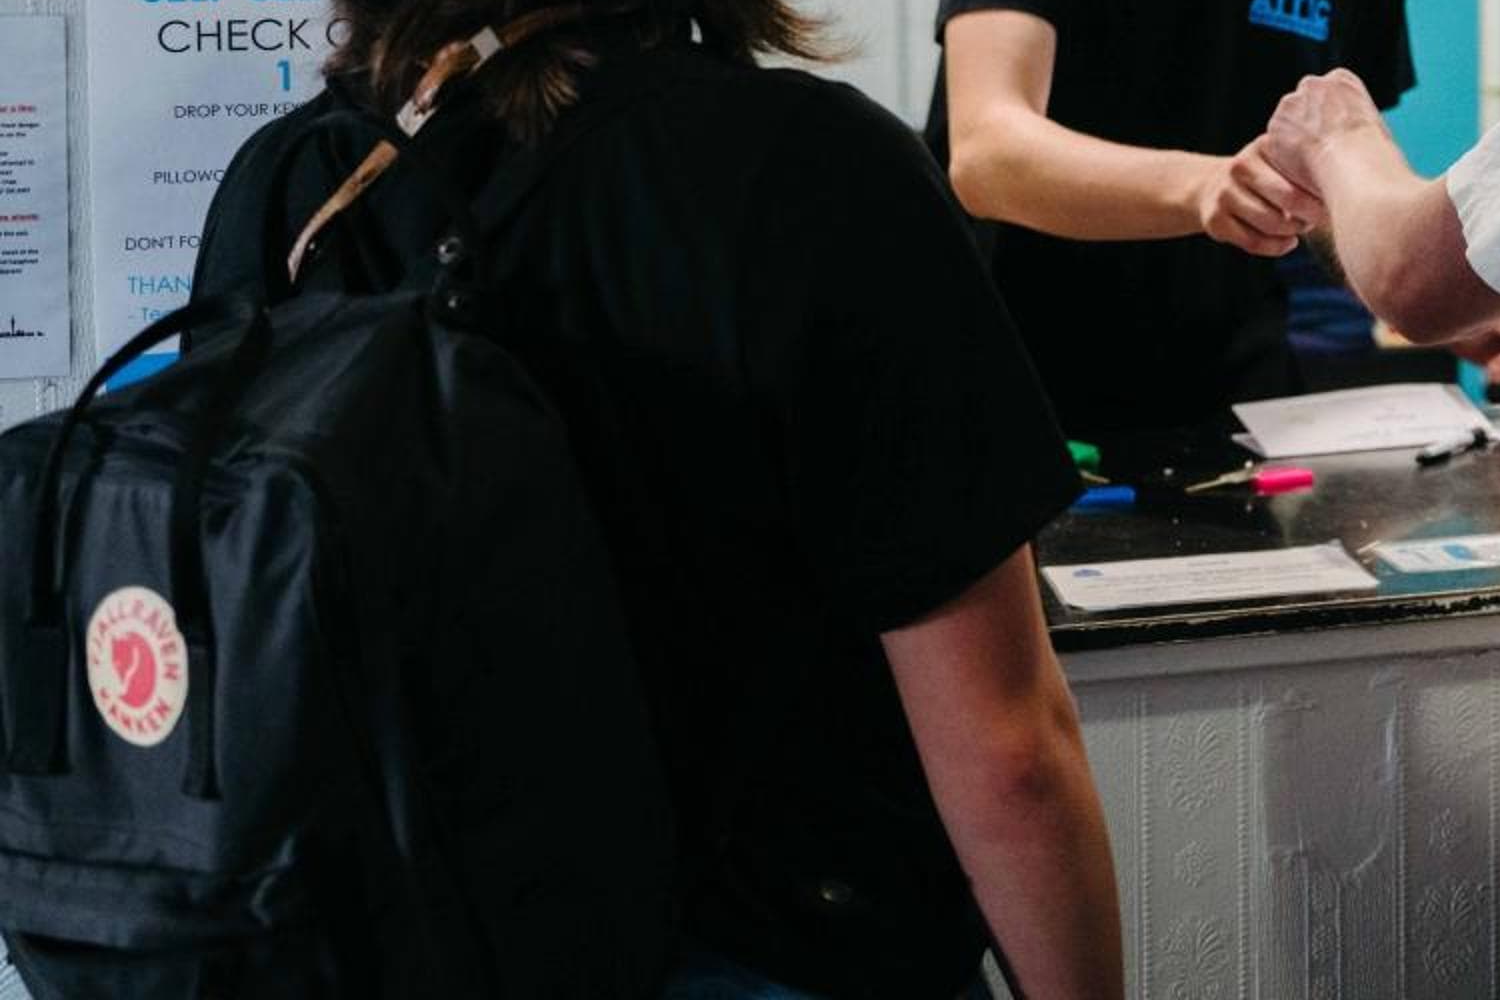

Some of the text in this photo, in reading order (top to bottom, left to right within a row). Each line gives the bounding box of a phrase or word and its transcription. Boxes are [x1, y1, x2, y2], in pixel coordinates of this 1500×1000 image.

[157, 18, 311, 53] CHECK
[276, 60, 291, 91] 1
[174, 104, 220, 118] DROP
[225, 103, 268, 117] YOUR
[125, 236, 173, 251] DON'T
